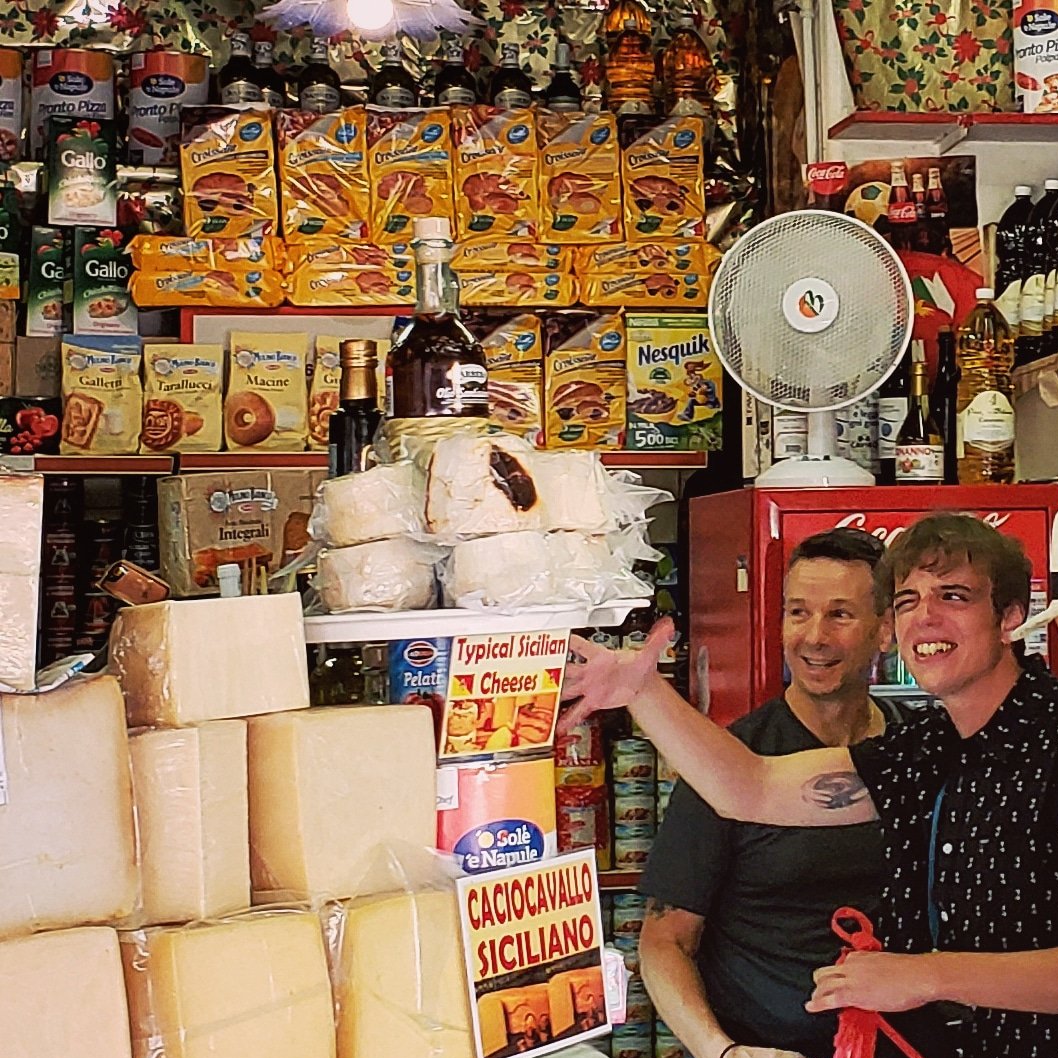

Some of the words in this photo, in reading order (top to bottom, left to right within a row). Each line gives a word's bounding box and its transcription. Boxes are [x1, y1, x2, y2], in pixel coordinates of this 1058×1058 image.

[60, 150, 107, 170] Gallo
[85, 259, 128, 279] Gallo
[638, 333, 711, 368] Nesquik
[246, 374, 290, 388] Macine
[634, 430, 664, 447] 500
[218, 524, 269, 542] Integrali
[457, 635, 514, 665] Typical
[518, 633, 566, 657] Sicilian
[404, 671, 441, 687] Pelati
[480, 671, 538, 696] Cheeses
[481, 846, 538, 868] Napule
[467, 862, 593, 930] CACIOCAVALLO
[477, 914, 594, 978] SICILIANO
